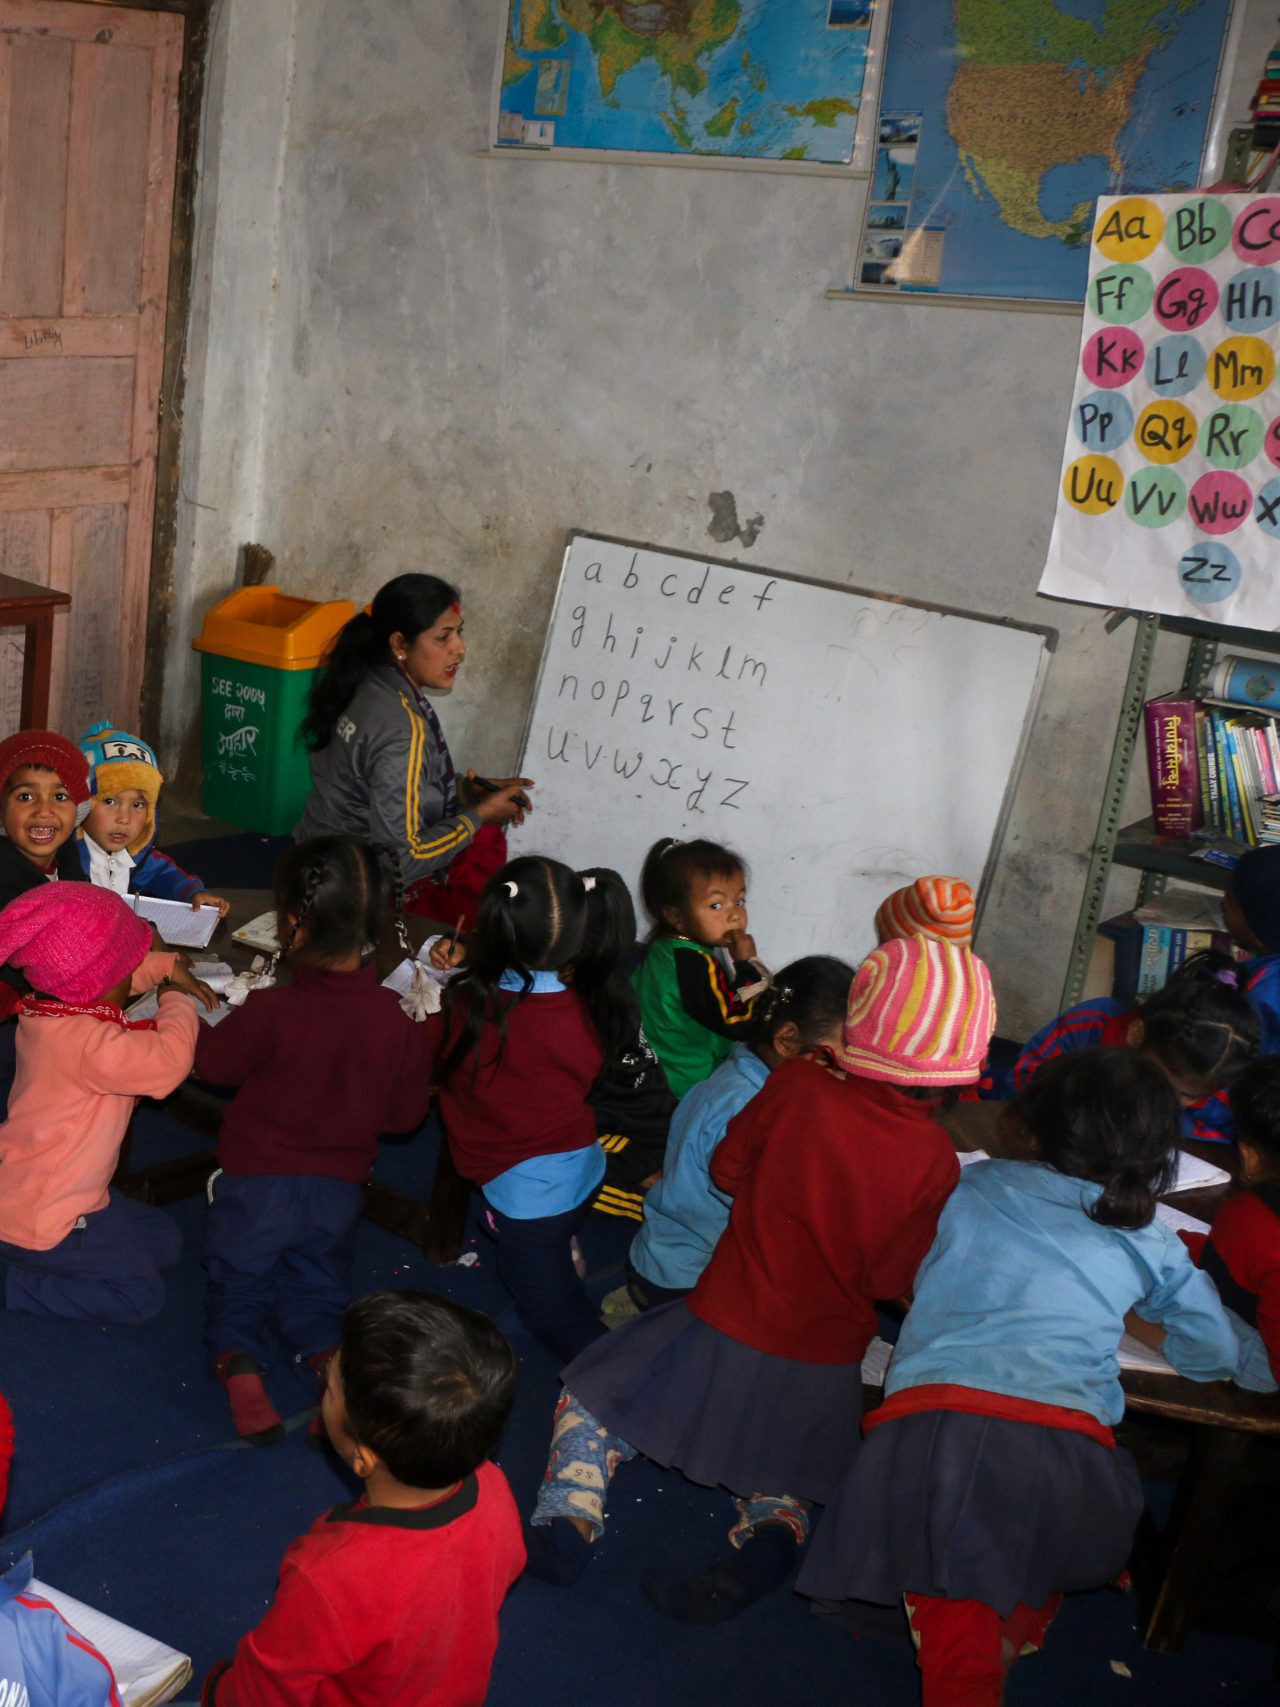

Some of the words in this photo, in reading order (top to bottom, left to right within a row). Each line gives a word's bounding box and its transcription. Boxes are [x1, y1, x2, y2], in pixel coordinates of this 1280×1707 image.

[1096, 210, 1150, 243] Aa
[1176, 202, 1216, 251] Bb
[1096, 275, 1134, 315] Ff
[1157, 278, 1208, 326] Gg
[1226, 280, 1272, 322] Hh
[1155, 346, 1188, 386] Ll
[1214, 350, 1263, 389] Mm
[1079, 403, 1113, 443] Pp
[1141, 413, 1192, 451] Qq
[1206, 413, 1249, 457] Rr
[1071, 466, 1116, 507] Uu
[1132, 480, 1176, 516] Vv
[1191, 491, 1247, 524] Ww
[1182, 556, 1231, 584] Zz
